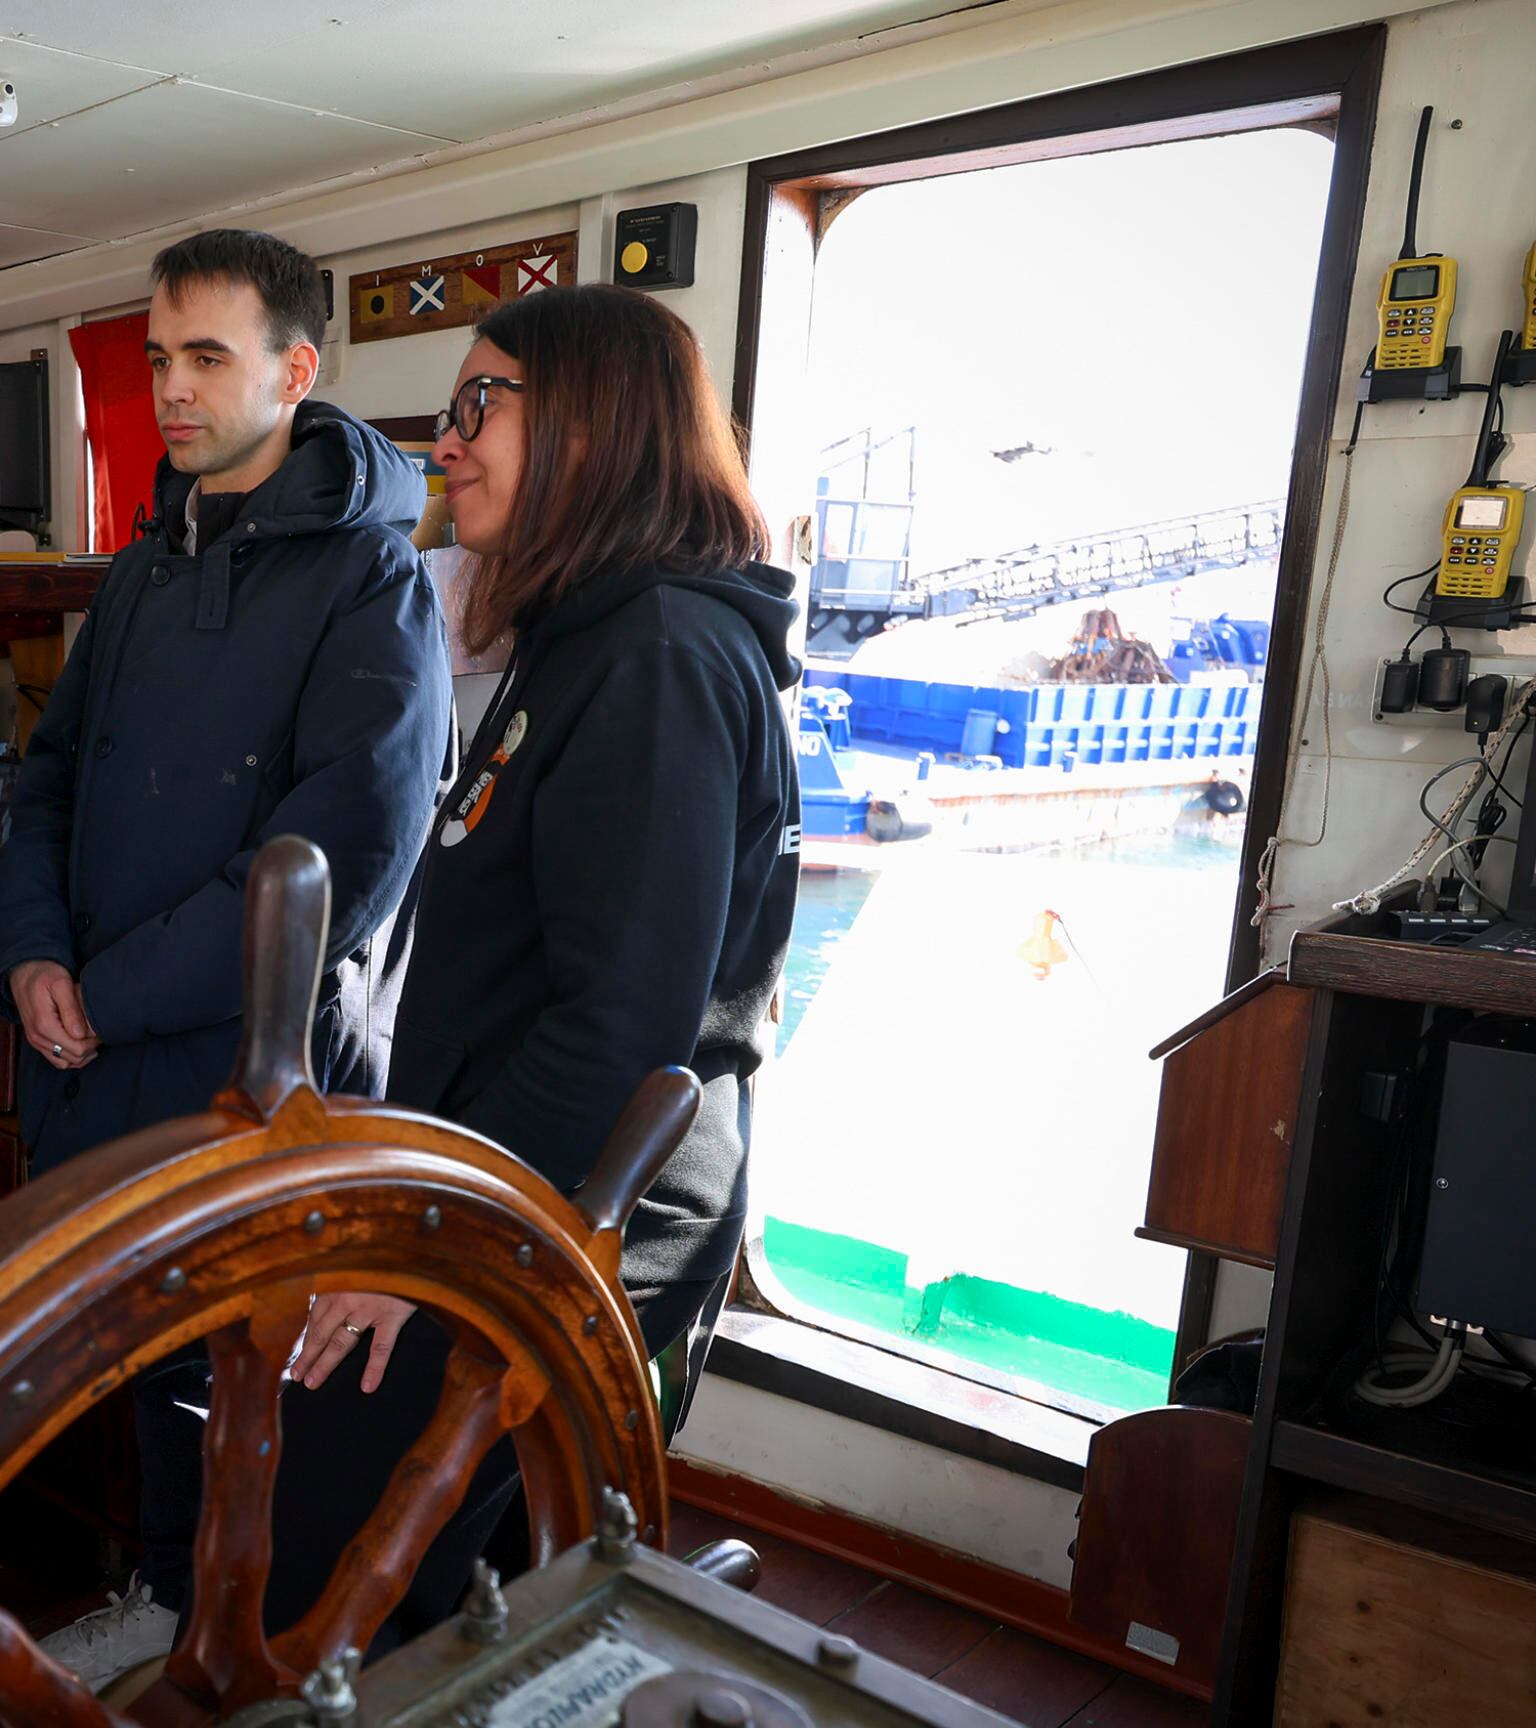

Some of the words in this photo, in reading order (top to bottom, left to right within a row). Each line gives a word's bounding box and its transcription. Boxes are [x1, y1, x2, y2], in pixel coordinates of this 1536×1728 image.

[421, 264, 432, 278] M
[475, 254, 484, 267] O
[532, 242, 544, 256] V
